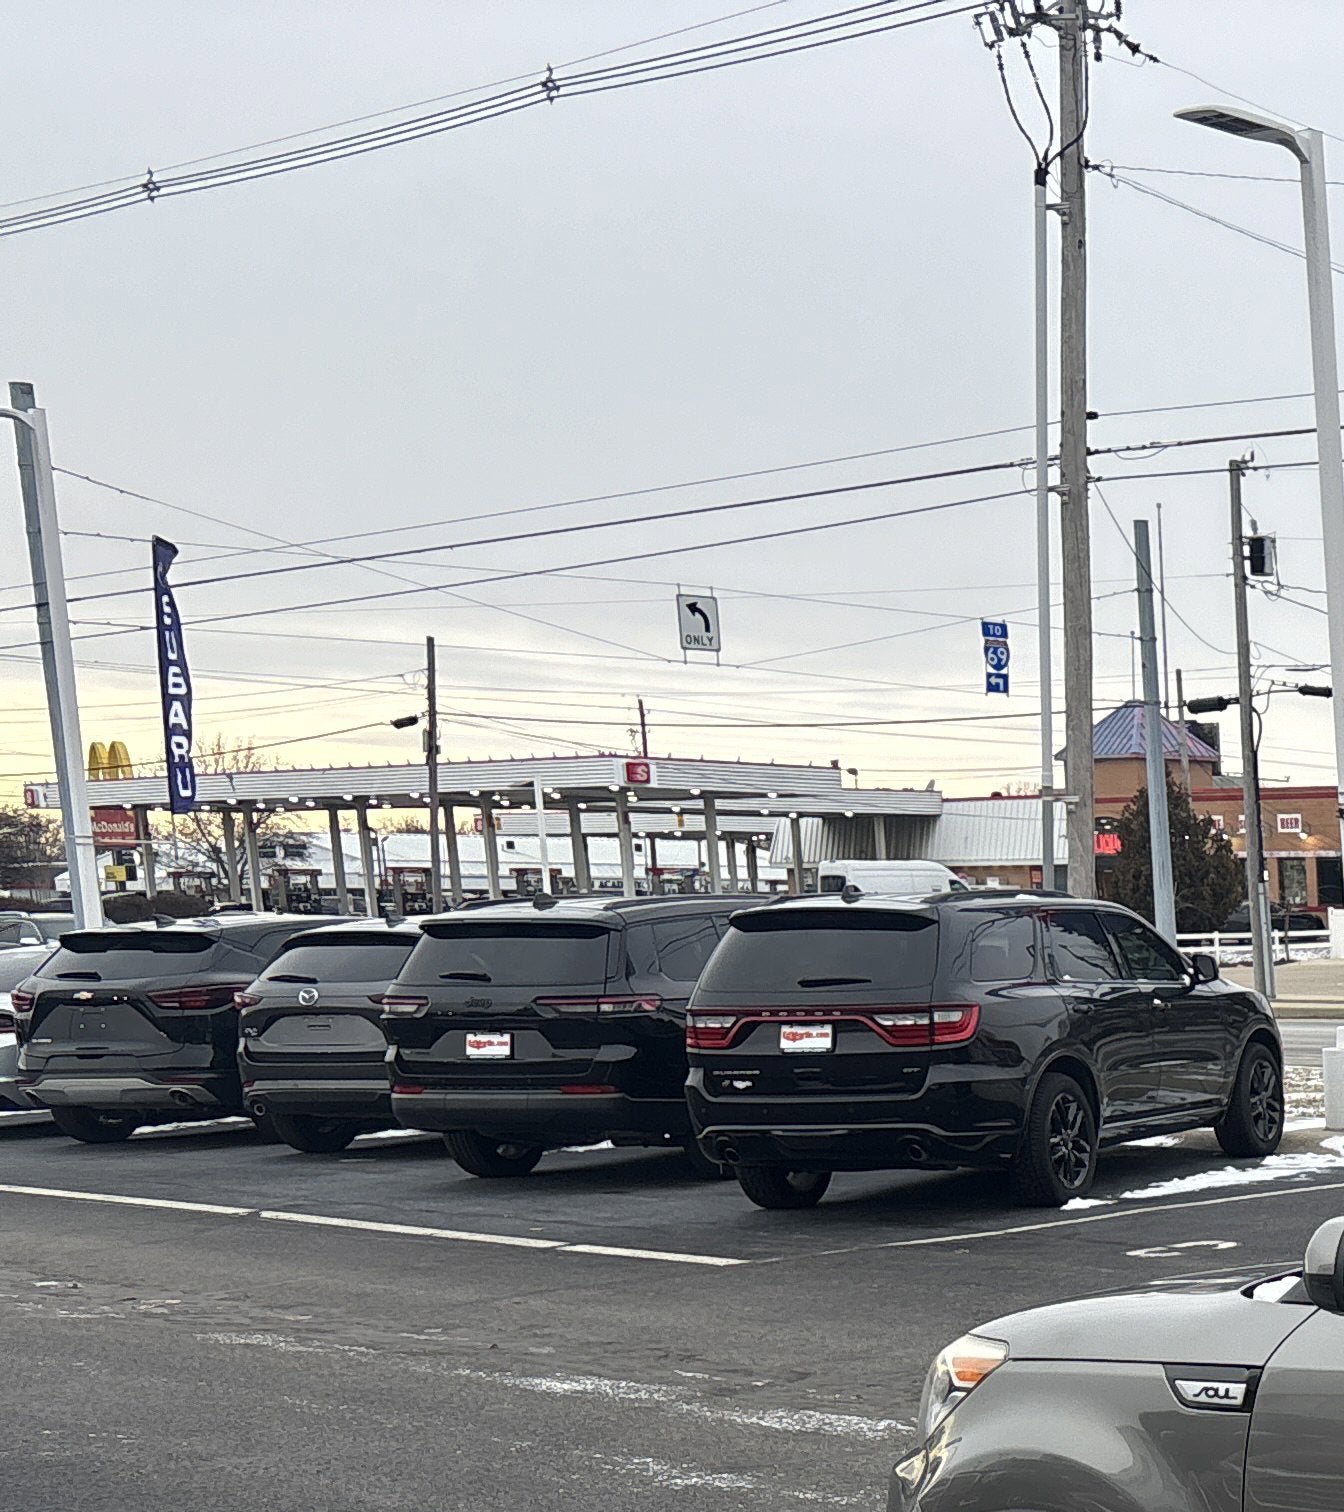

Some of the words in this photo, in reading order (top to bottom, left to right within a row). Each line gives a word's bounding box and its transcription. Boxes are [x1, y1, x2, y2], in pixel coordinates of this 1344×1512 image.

[685, 633, 714, 647] ONLY
[987, 647, 1007, 666] 69
[161, 594, 193, 798] SUBARU
